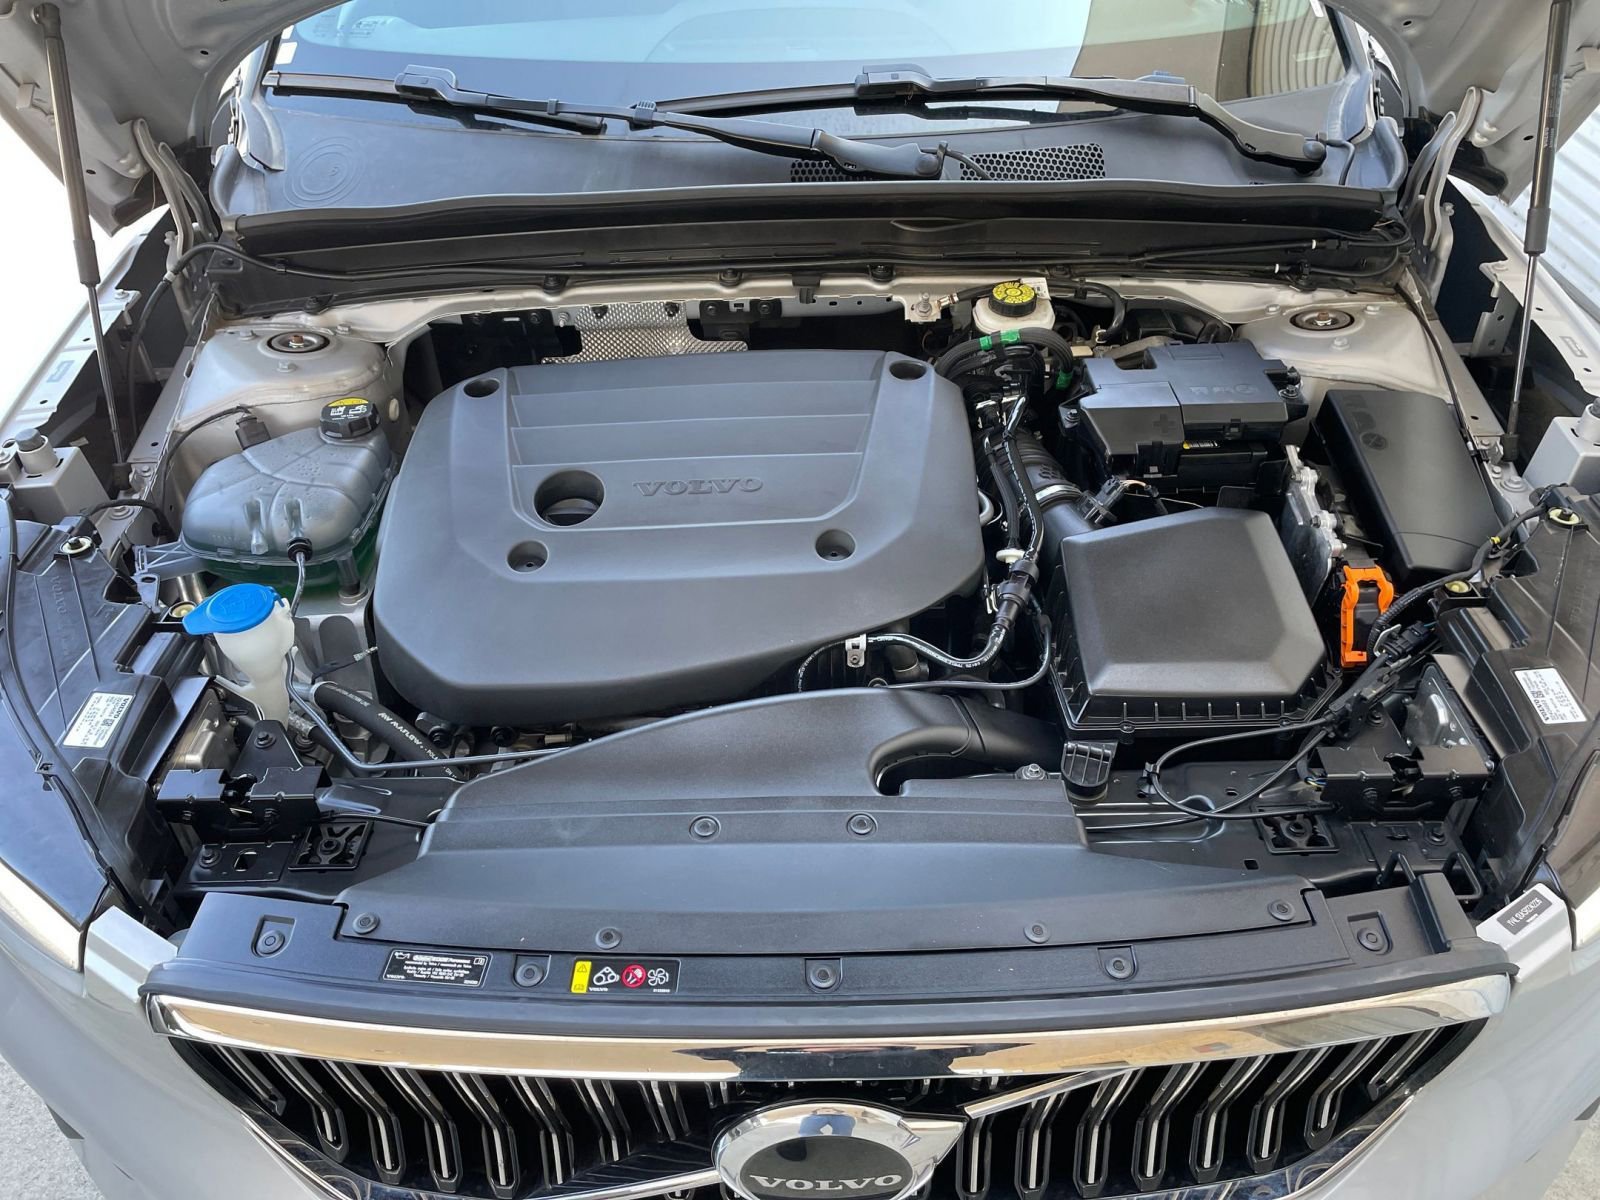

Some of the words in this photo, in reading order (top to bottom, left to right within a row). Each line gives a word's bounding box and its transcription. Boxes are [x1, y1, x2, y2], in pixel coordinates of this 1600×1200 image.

[633, 478, 763, 496] VOLVO
[113, 697, 130, 719] VOLVO
[1533, 699, 1550, 721] VOLVO
[750, 1174, 902, 1191] VOLVO
